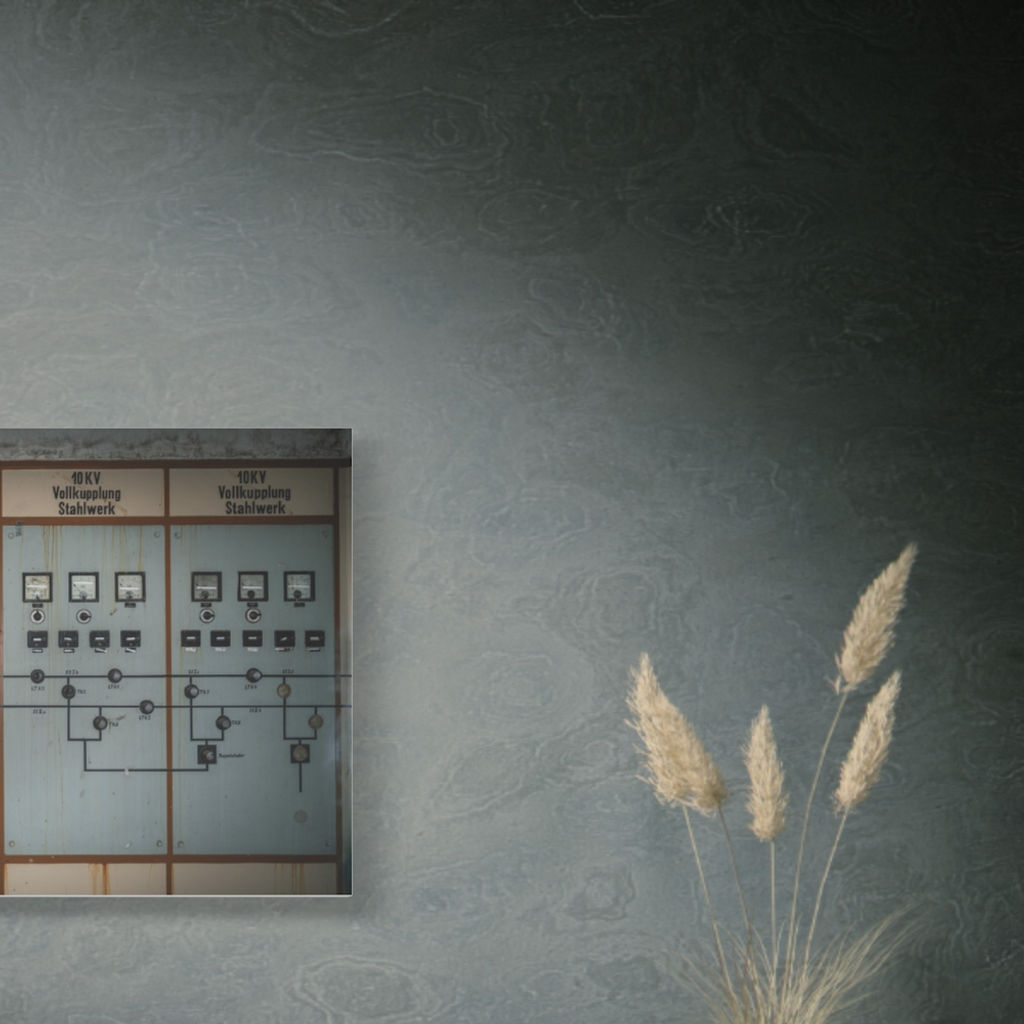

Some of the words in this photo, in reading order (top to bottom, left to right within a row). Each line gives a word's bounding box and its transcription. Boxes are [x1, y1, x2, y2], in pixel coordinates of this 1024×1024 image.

[52, 485, 121, 502] Vollkupplung
[218, 485, 291, 501] Vollkupplung
[58, 501, 116, 516] Stahlwerk
[225, 500, 286, 515] Stahlwerk
